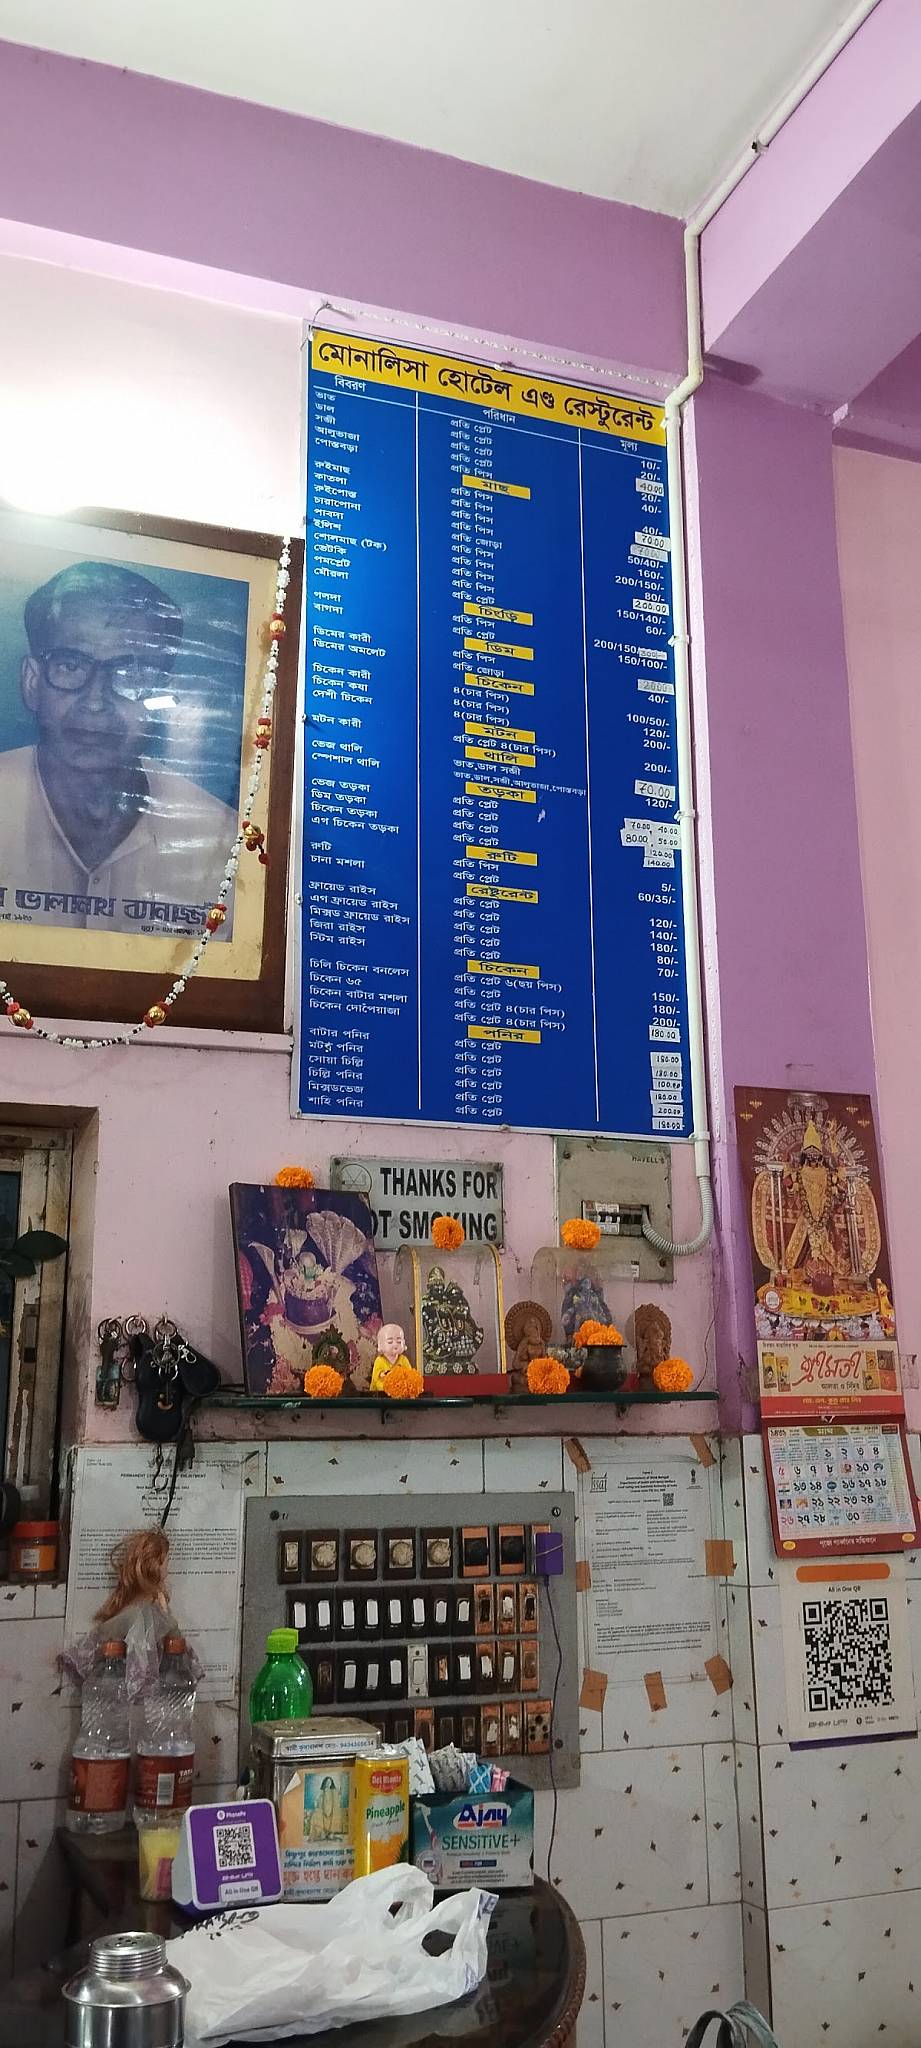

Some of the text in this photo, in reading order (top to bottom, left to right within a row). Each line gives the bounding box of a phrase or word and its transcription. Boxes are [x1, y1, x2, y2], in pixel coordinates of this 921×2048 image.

[319, 342, 429, 383] মোনালিসা
[438, 368, 512, 401] হোটেল
[334, 375, 366, 392] বিবরণ
[482, 408, 516, 424] পরিধান
[640, 460, 660, 470] 10/-
[640, 471, 660, 481] 20/-
[313, 496, 361, 511] চারাপোনা
[641, 492, 661, 503] 20/-
[313, 508, 344, 520] পাবদা
[641, 504, 661, 514] 40/-
[312, 517, 341, 531] ইলিশ
[641, 525, 663, 536] 40/-
[451, 532, 471, 542] প্রতি
[627, 555, 664, 569] 50/40/-
[637, 568, 664, 580] 160/-
[615, 575, 665, 591] 200/150/-
[644, 591, 665, 602] 80/-
[616, 609, 666, 625] 150/140/-
[312, 624, 371, 643] ডিমের কারী
[645, 625, 666, 636] 60/-
[312, 637, 386, 657] ডিমের অমলেট
[484, 641, 514, 656] ডিম
[618, 654, 667, 670] 150/100/-
[312, 661, 371, 680] চিকেন কারী
[475, 675, 523, 692] চিকেন
[312, 688, 373, 705] দেশী চিকেন
[484, 689, 509, 703] পিস)
[647, 693, 669, 704] 40/-
[311, 713, 362, 728] মটন কারী
[626, 713, 669, 727] 100/50/-
[482, 726, 517, 740] মটন
[643, 727, 670, 739] 120/-
[311, 739, 363, 753] ভেজ থালি
[643, 738, 671, 750] 200/-
[483, 751, 518, 764] থালি
[644, 762, 671, 774] 200/-
[310, 788, 332, 800] ডিম
[645, 798, 673, 809] 120/-
[311, 816, 329, 825] এগ
[332, 816, 365, 829] চিকেন
[335, 857, 365, 868] মশলা
[485, 850, 518, 862] রুটি
[661, 883, 676, 892] 5/-
[638, 892, 676, 904] 60/35/-
[309, 917, 365, 933] জিরা রাইস
[649, 917, 677, 929] 120/-
[649, 930, 678, 941] 140/-
[650, 942, 678, 953] 180/-
[656, 955, 679, 965] 80/-
[309, 957, 409, 977] চিলি চিকেন বনলেস
[477, 962, 529, 976] চিকেন
[657, 967, 679, 978] 70/-
[309, 971, 362, 986] চিকেন ৬৫
[454, 972, 476, 983] প্রতি
[536, 980, 561, 991] পিস)
[309, 984, 407, 1003] চিকেন বাটার মশলা
[652, 991, 680, 1003] 150/-
[652, 1004, 680, 1015] 180/-
[309, 1027, 369, 1040] বাটার পনির
[482, 1028, 524, 1041] পনির
[308, 1095, 363, 1107] শাহি পনির
[380, 1167, 498, 1199] THANKS FOR
[399, 1210, 497, 1241] SMING
[793, 1482, 807, 1491] ১৩
[809, 1482, 822, 1490] ১৪
[859, 1479, 871, 1487] ১৭
[366, 1799, 405, 1820] Pineapple
[458, 1802, 508, 1827] Ajay
